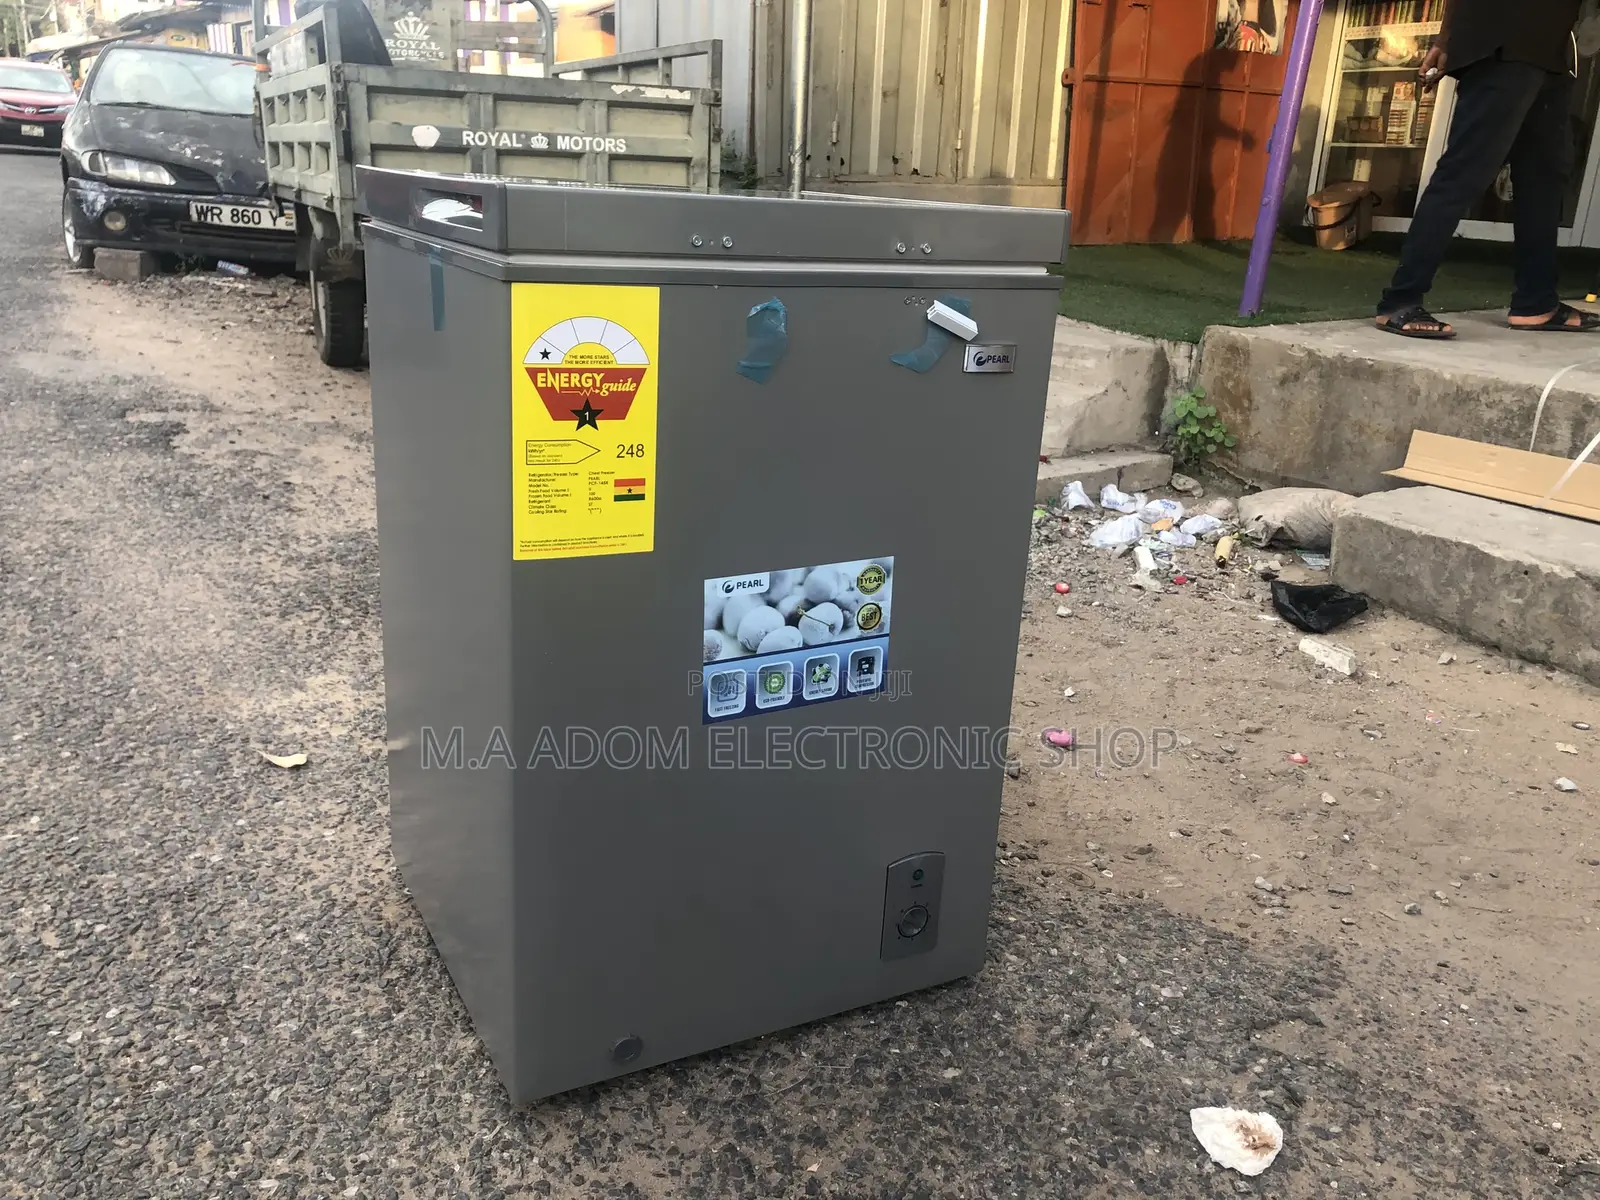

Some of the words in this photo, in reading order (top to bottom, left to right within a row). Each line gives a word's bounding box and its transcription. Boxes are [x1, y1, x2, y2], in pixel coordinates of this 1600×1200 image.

[384, 38, 440, 50] ROYAL
[387, 48, 444, 58] OTORCYCLE
[462, 130, 522, 148] ROYAL
[557, 135, 627, 153] MOTORS
[195, 204, 223, 223] WR
[230, 208, 262, 225] 860
[269, 210, 278, 227] Y
[986, 354, 1010, 364] PEARL
[537, 368, 605, 393] ENERGY
[600, 377, 637, 396] guide
[584, 411, 589, 421] 1
[616, 443, 645, 459] 248
[736, 579, 764, 590] PEARL
[861, 611, 878, 622] BEST
